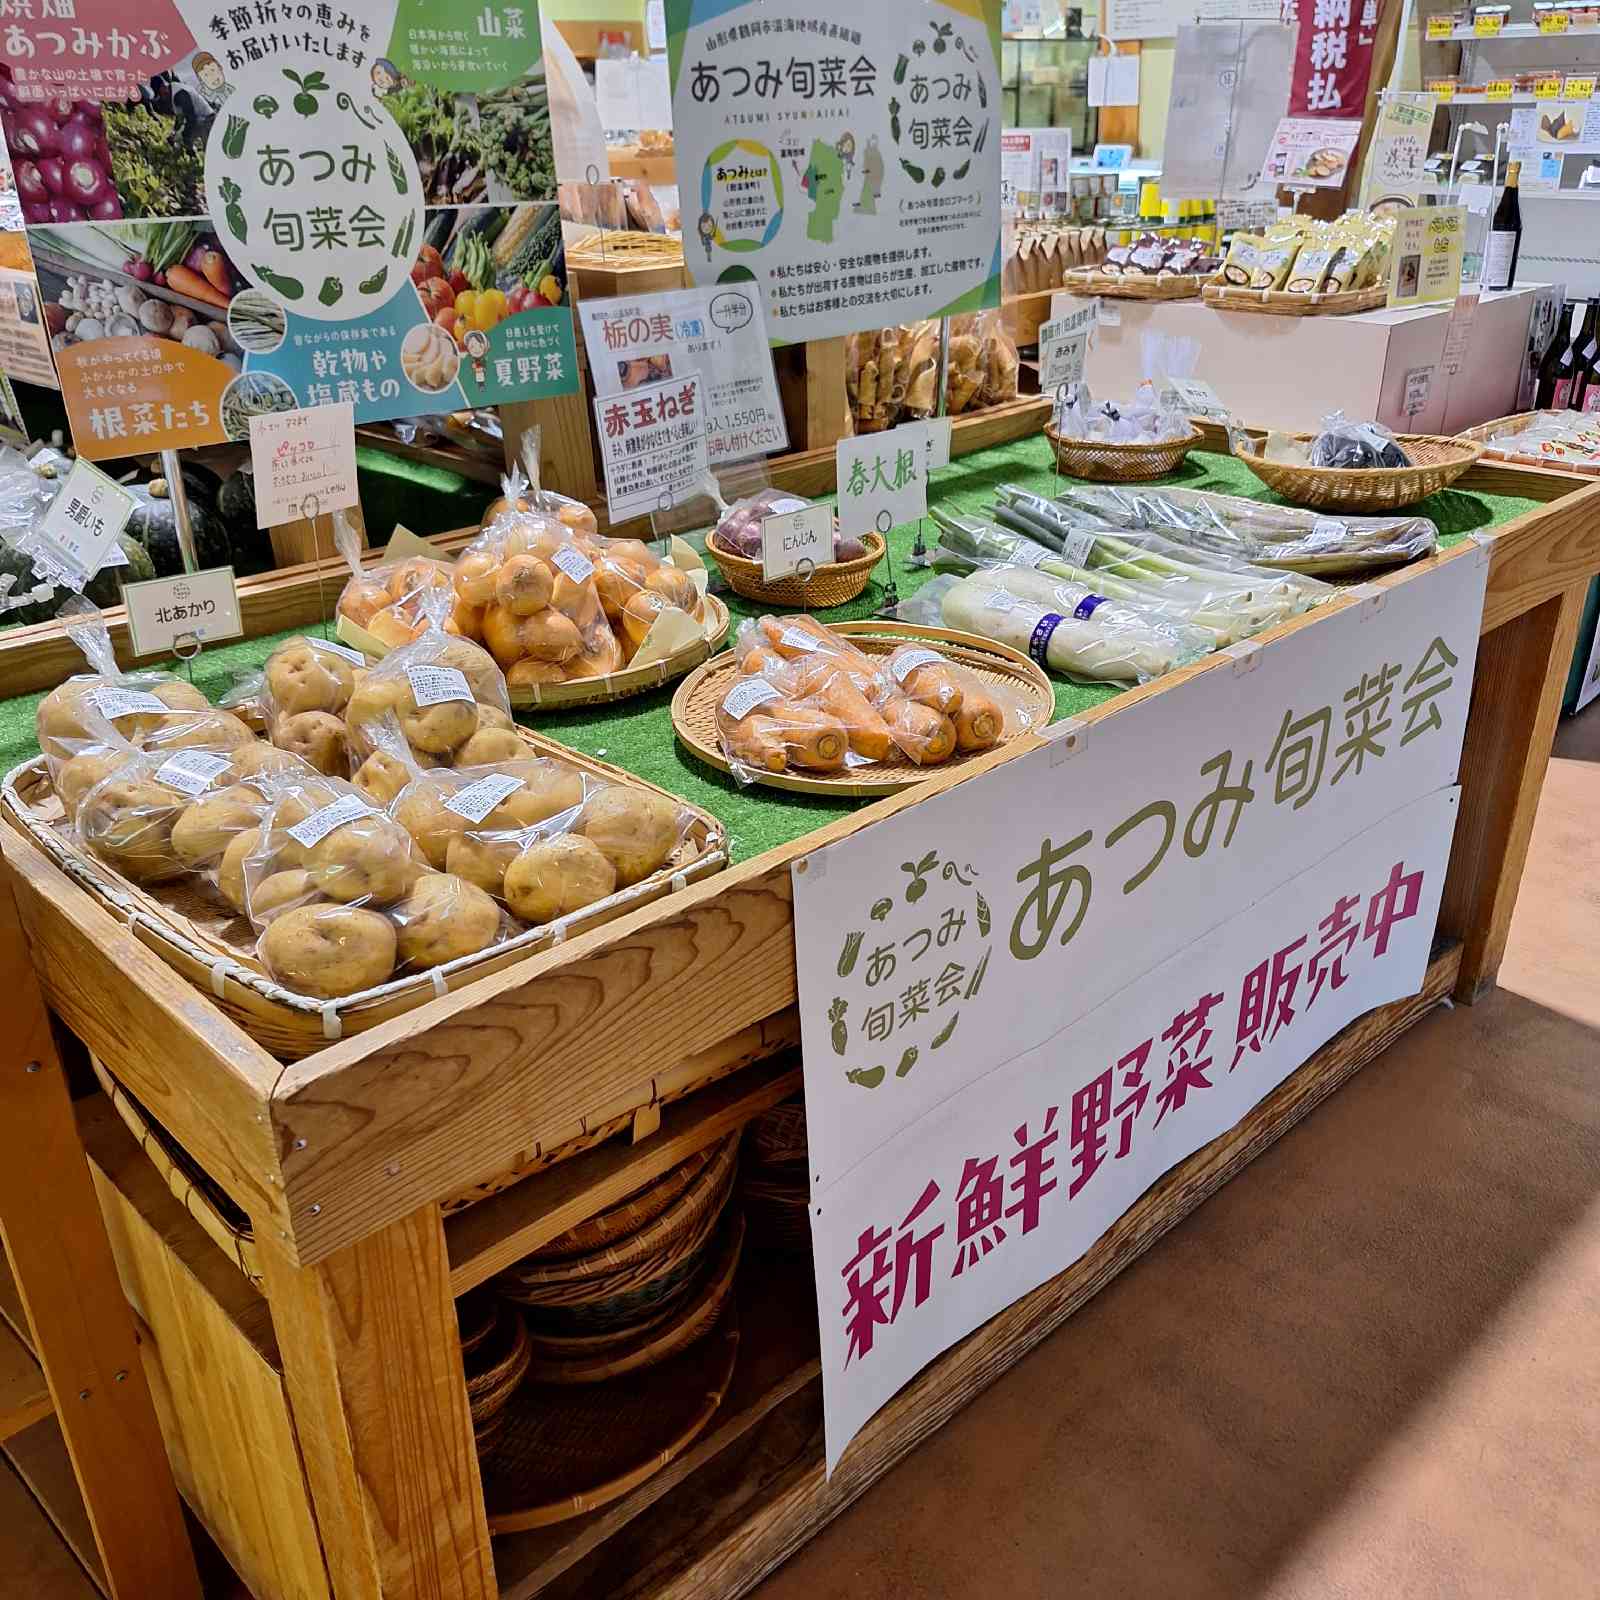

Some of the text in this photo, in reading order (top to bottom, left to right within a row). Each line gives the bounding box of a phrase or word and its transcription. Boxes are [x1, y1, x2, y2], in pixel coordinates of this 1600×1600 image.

[208, 1, 372, 41] 季節折々の恵みを
[477, 7, 527, 39] 山菜
[4, 24, 171, 60] あつみかぶ
[226, 32, 368, 69] お届けいたします
[691, 54, 877, 103] あつみ旬菜会
[910, 73, 972, 104] あつみ
[908, 116, 973, 150] 旬菜会
[256, 144, 376, 187] あつみ
[263, 205, 385, 251] 旬菜会
[603, 313, 674, 350] 栃の実
[312, 349, 387, 378] 乾物や
[494, 352, 564, 387] 夏野菜
[307, 379, 400, 408] 塩蔵もの
[604, 382, 697, 438] 赤玉ねぎ
[89, 401, 210, 440] 根菜たち
[847, 448, 917, 497] 春大根
[65, 498, 104, 536] 男爵いも
[783, 530, 817, 552] にんじん
[155, 599, 216, 623] 北あかり
[1009, 635, 1458, 960] あつみ旬菜会
[865, 908, 966, 987] あつみ
[861, 962, 966, 1041] 旬菜会
